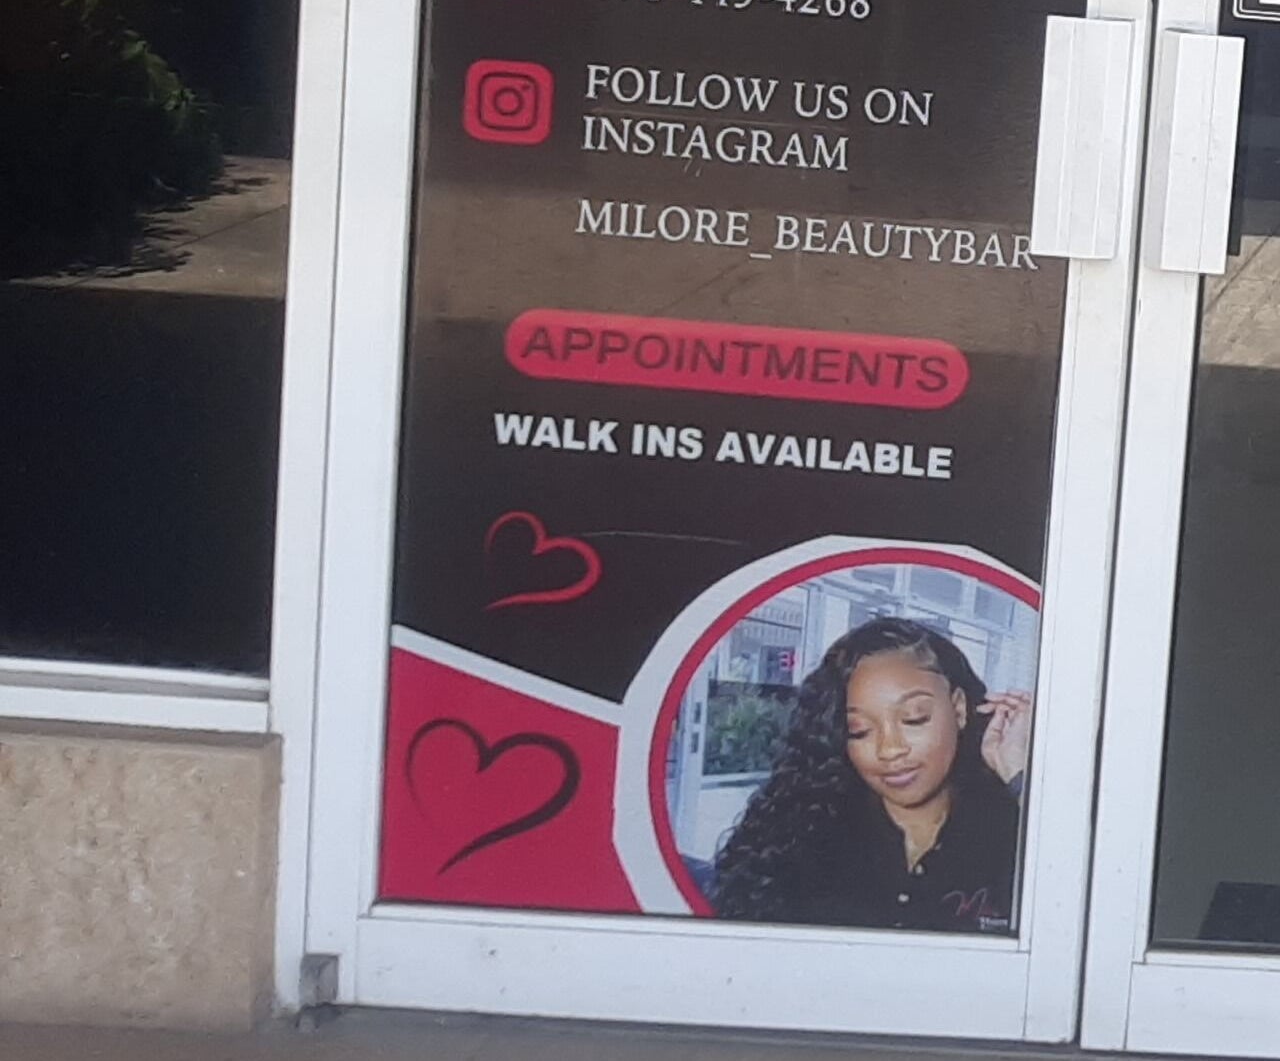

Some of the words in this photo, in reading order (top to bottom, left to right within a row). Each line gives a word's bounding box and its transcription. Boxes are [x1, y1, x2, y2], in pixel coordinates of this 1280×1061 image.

[585, 64, 776, 114] FOLLOW
[793, 81, 849, 120] US
[863, 87, 934, 127] ON
[582, 116, 850, 172] INSTAGRAM
[575, 198, 1040, 271] MILORE_BEAUTYBAR
[520, 324, 951, 394] APPOINTMENTS
[494, 413, 618, 453] WALK
[631, 425, 704, 461] INS
[715, 431, 953, 480] AVAILABLE
